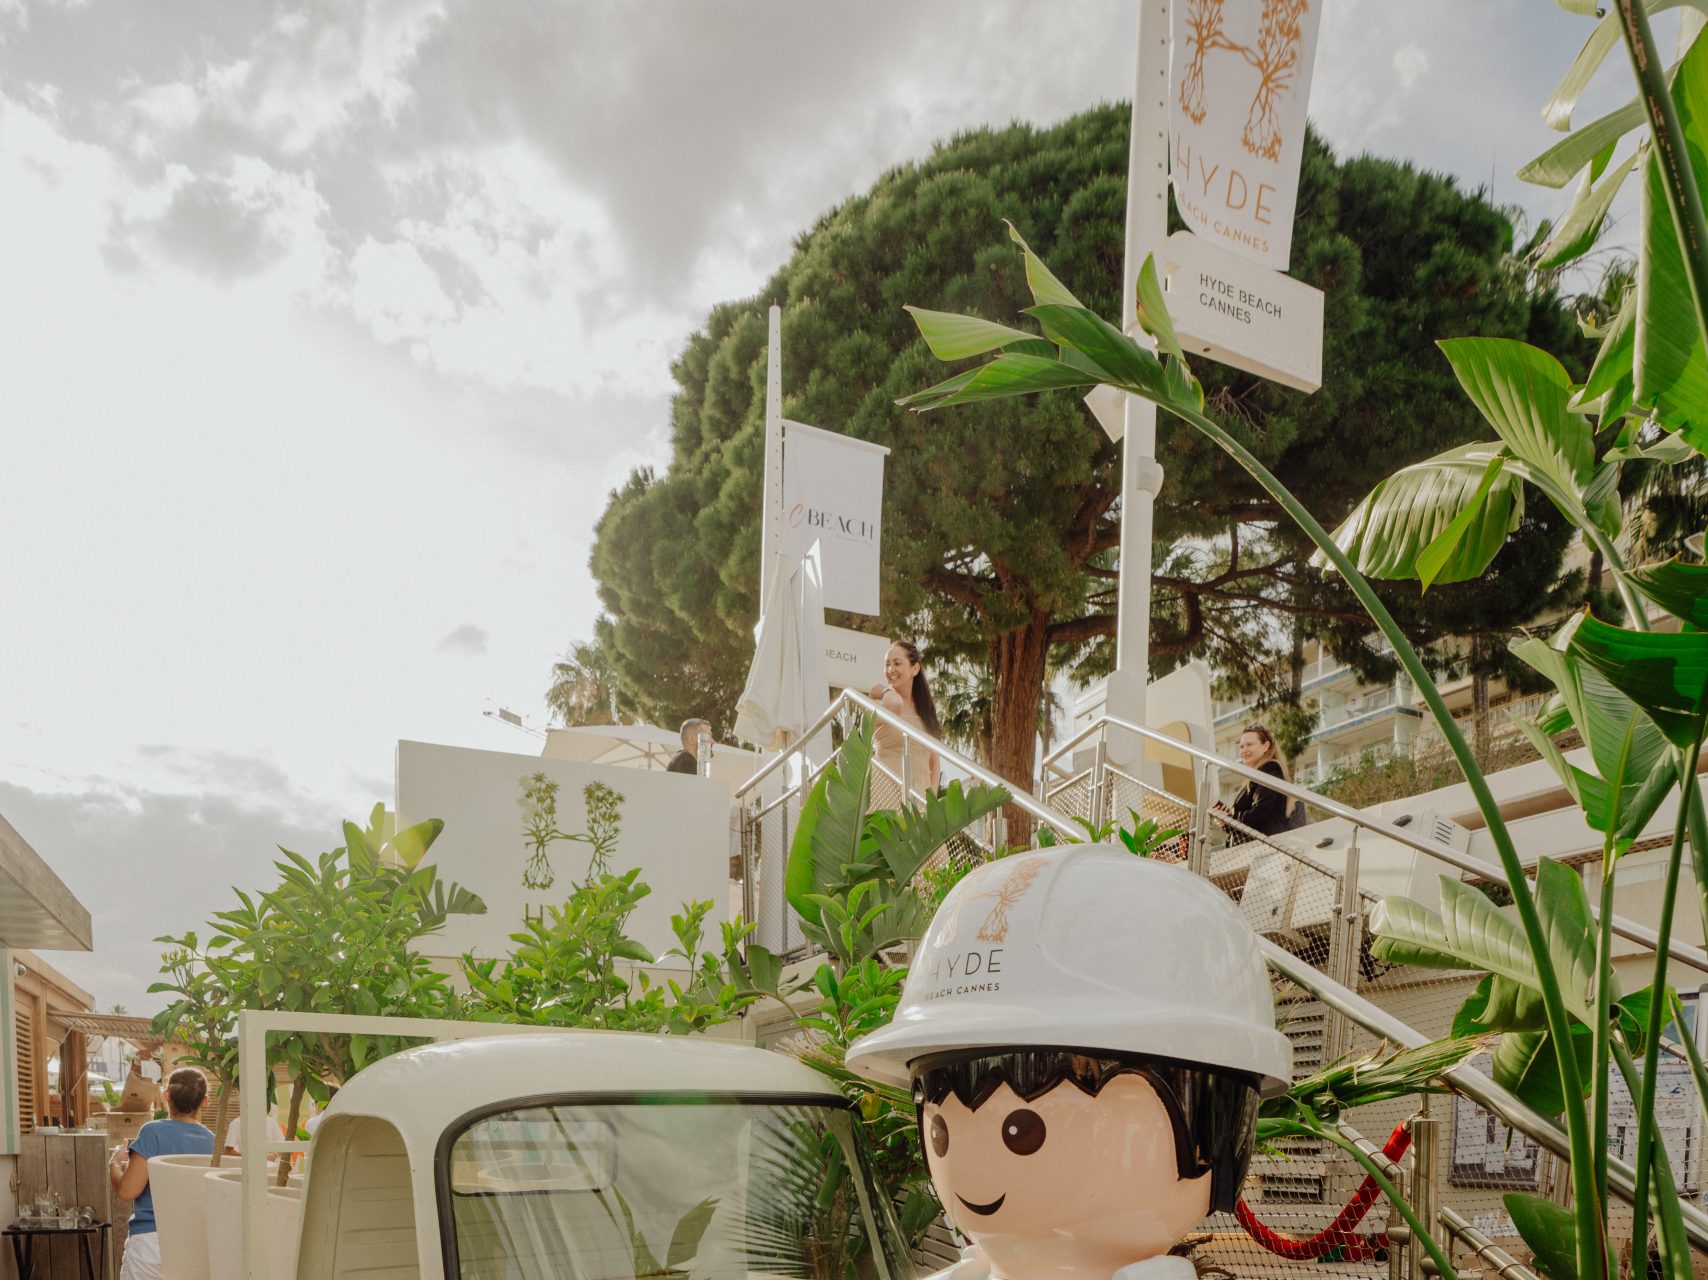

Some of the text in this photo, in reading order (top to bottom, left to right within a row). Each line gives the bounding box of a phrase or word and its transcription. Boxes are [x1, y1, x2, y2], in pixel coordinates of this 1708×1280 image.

[1176, 133, 1276, 225] HYDE
[1213, 220, 1270, 252] CANNES
[1199, 272, 1282, 319] HYDE BEACH
[1199, 293, 1251, 324] CANNES
[808, 508, 874, 540] BEACH
[956, 982, 1000, 995] CANNES
